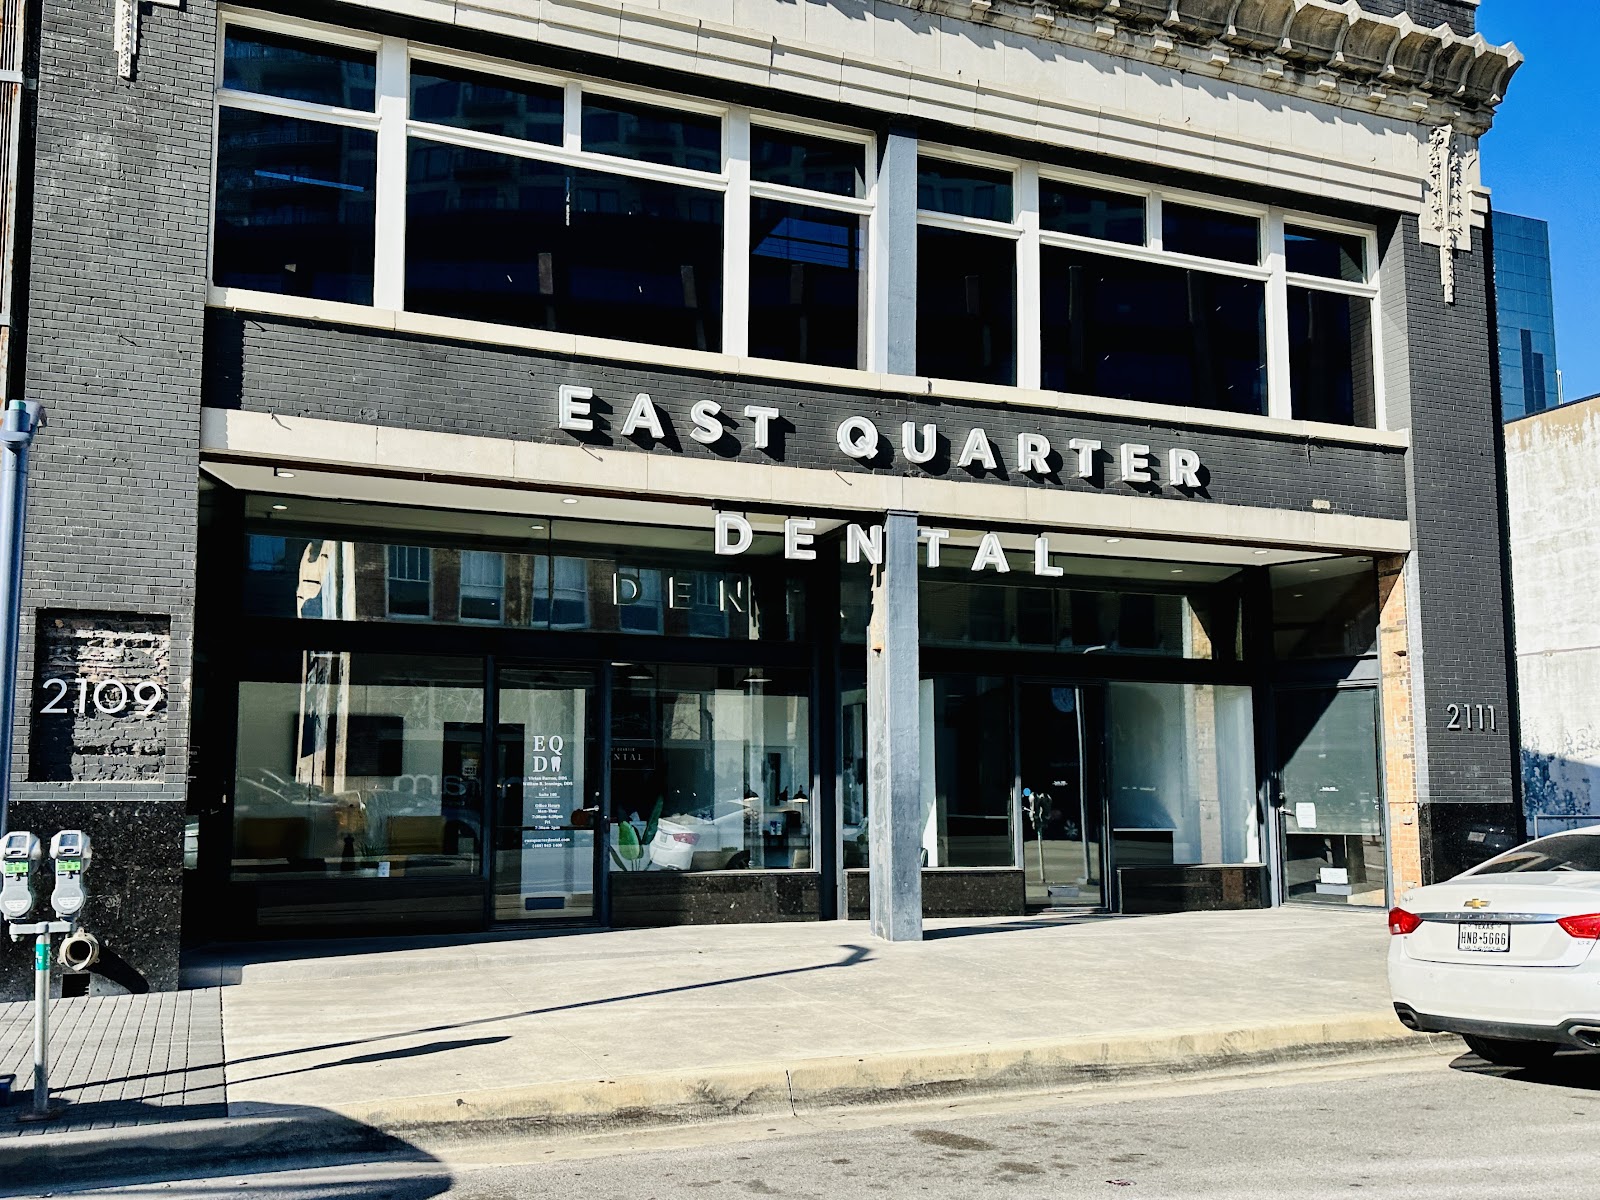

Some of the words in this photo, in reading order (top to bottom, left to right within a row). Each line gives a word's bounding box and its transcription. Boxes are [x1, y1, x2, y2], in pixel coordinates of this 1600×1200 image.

[559, 385, 779, 449] EAST
[837, 416, 1201, 488] QUARTER
[714, 510, 1064, 577] DENTAL
[40, 678, 161, 716] 2109
[1447, 704, 1496, 730] 2111
